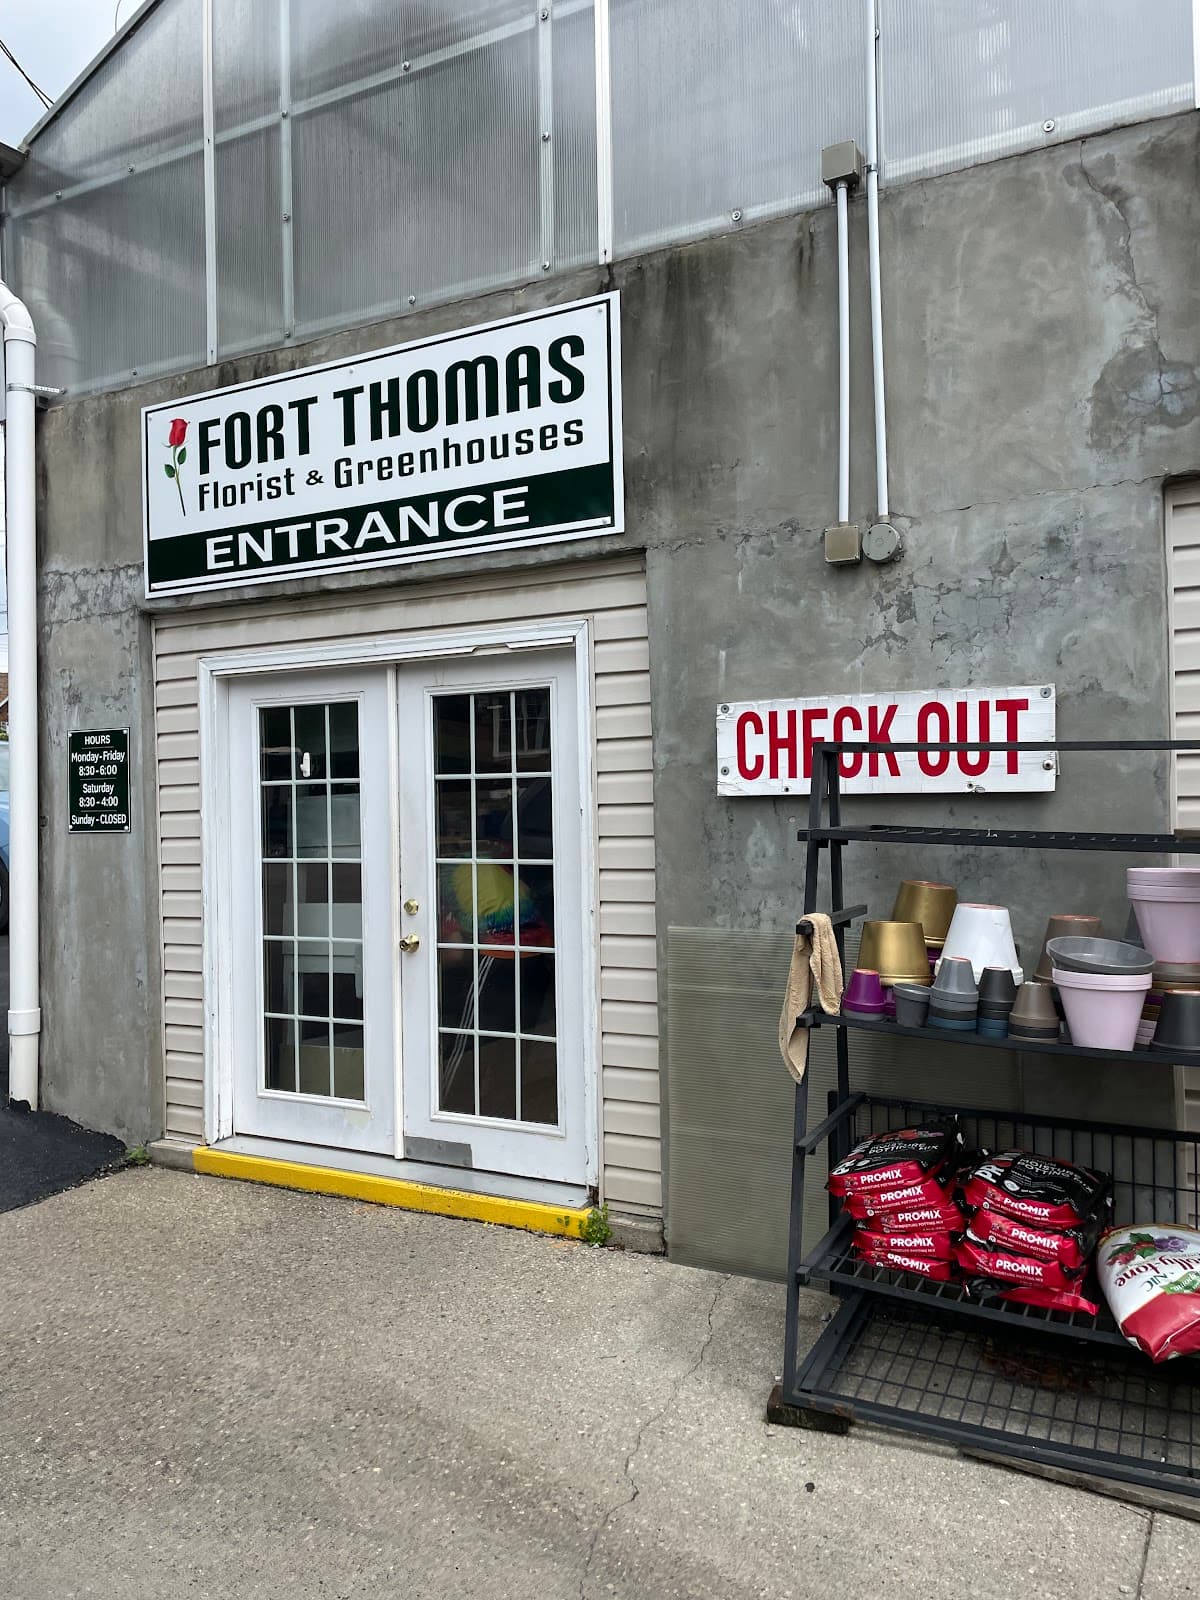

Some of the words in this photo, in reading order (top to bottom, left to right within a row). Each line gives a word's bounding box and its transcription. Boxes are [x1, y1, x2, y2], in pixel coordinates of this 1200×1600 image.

[199, 395, 318, 475] FORT
[334, 334, 585, 447] THOMAS
[199, 467, 295, 512] Florist
[306, 469, 325, 486] &
[334, 418, 584, 489] Greenhouses
[205, 485, 530, 570] ENTRANCE
[84, 734, 111, 745] HOURS
[917, 698, 1029, 777] OUT
[82, 782, 115, 795] Saturday
